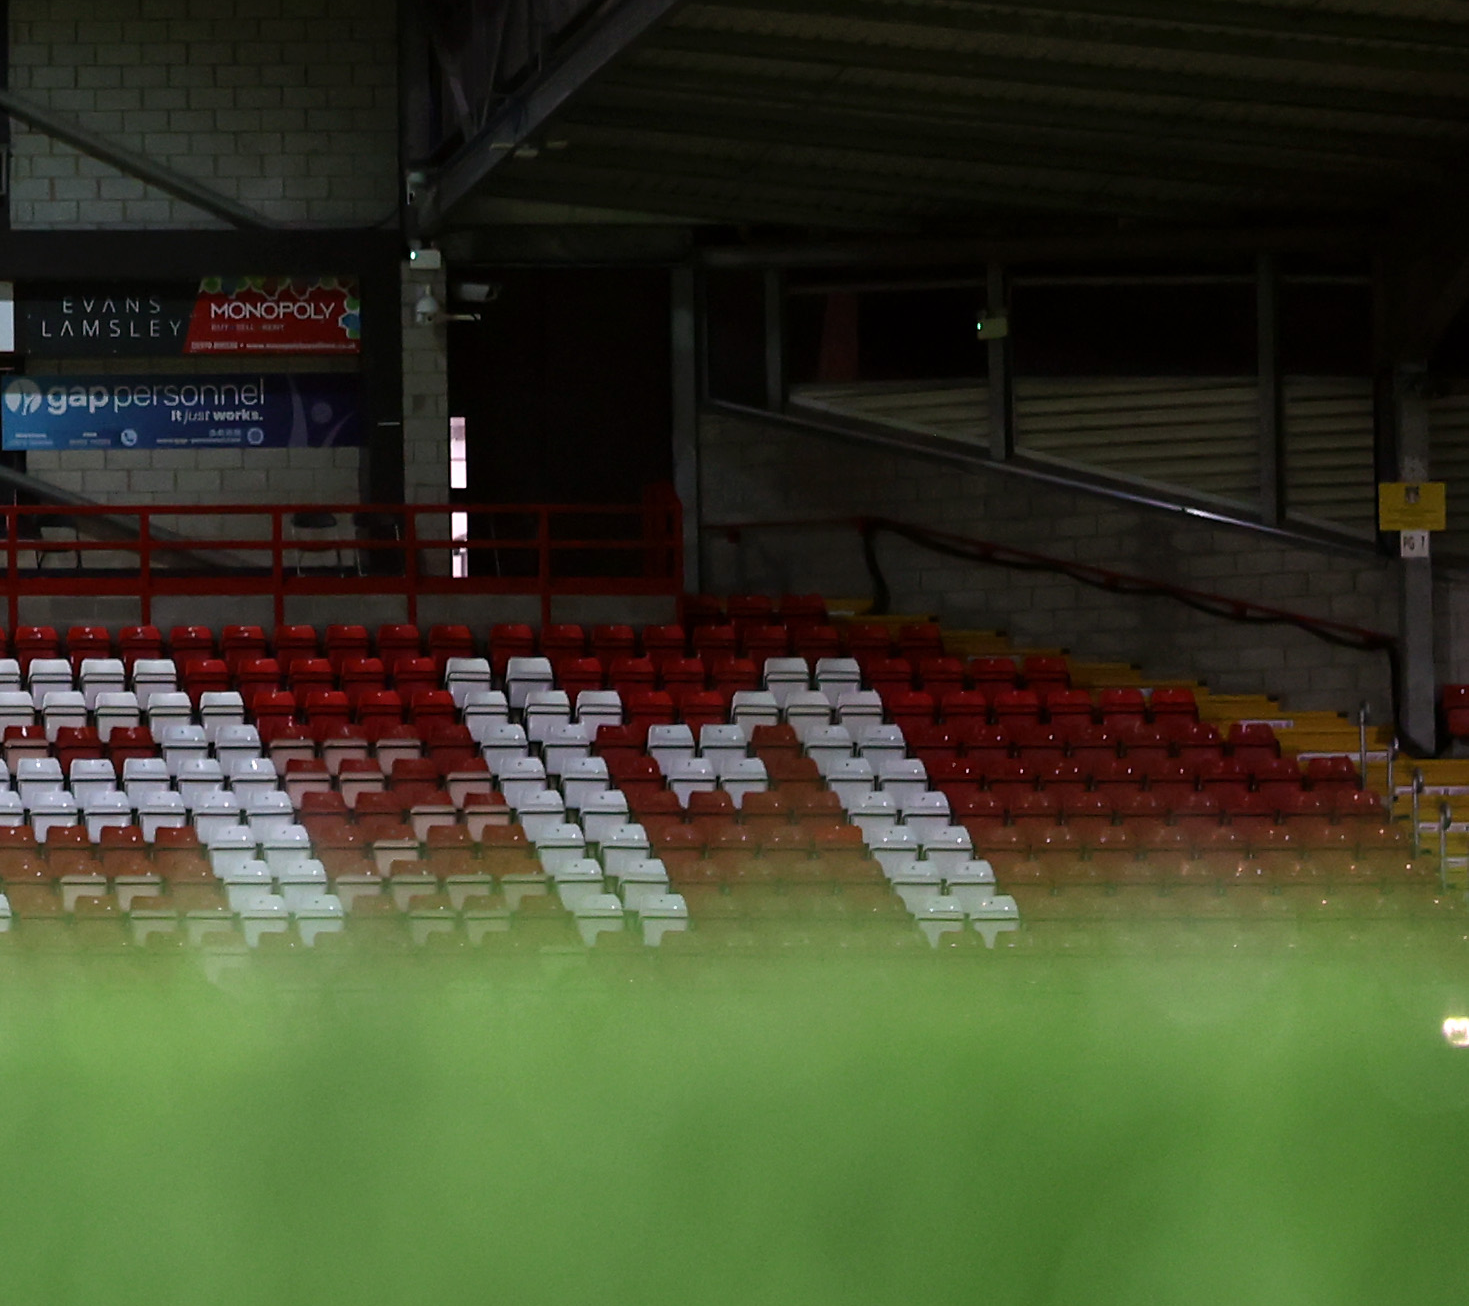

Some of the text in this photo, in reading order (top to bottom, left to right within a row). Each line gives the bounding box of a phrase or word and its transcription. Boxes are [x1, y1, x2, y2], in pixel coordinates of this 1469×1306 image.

[210, 302, 335, 319] MONOPOLY
[42, 320, 181, 337] LAMSLEY
[47, 378, 264, 415] gap personnel
[212, 409, 263, 422] works.
